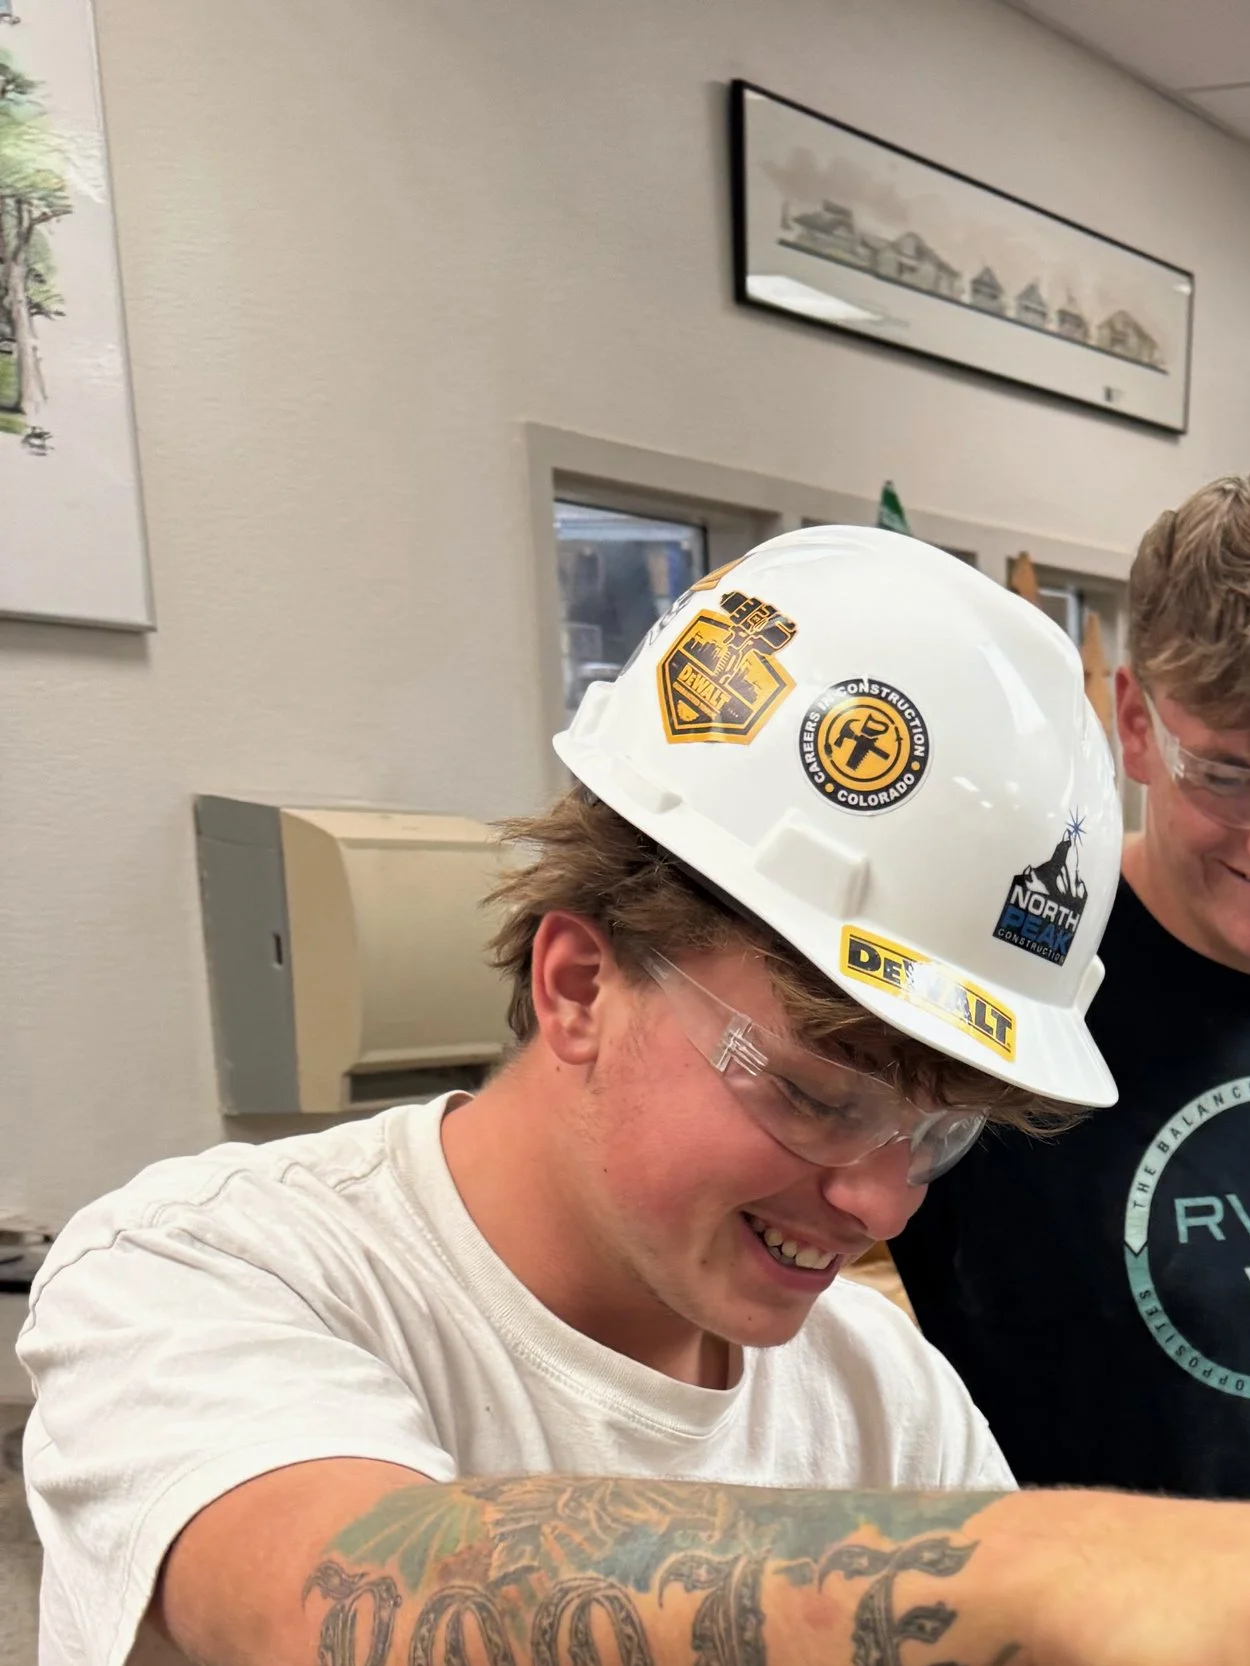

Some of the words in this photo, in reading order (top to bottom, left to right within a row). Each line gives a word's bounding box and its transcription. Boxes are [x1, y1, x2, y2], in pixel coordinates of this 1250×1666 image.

[803, 711, 826, 784] CAREERS
[817, 694, 836, 711] IN
[836, 683, 925, 757] CONSTRUCTION
[837, 773, 915, 807] COLORADO
[1000, 905, 1073, 954] PEAK
[1009, 884, 1081, 932] NORTH
[997, 928, 1066, 965] CONSTRUCTION
[848, 937, 1013, 1045] DEALT
[1132, 1166, 1156, 1211] THE
[1139, 1288, 1245, 1392] OPPOSITES
